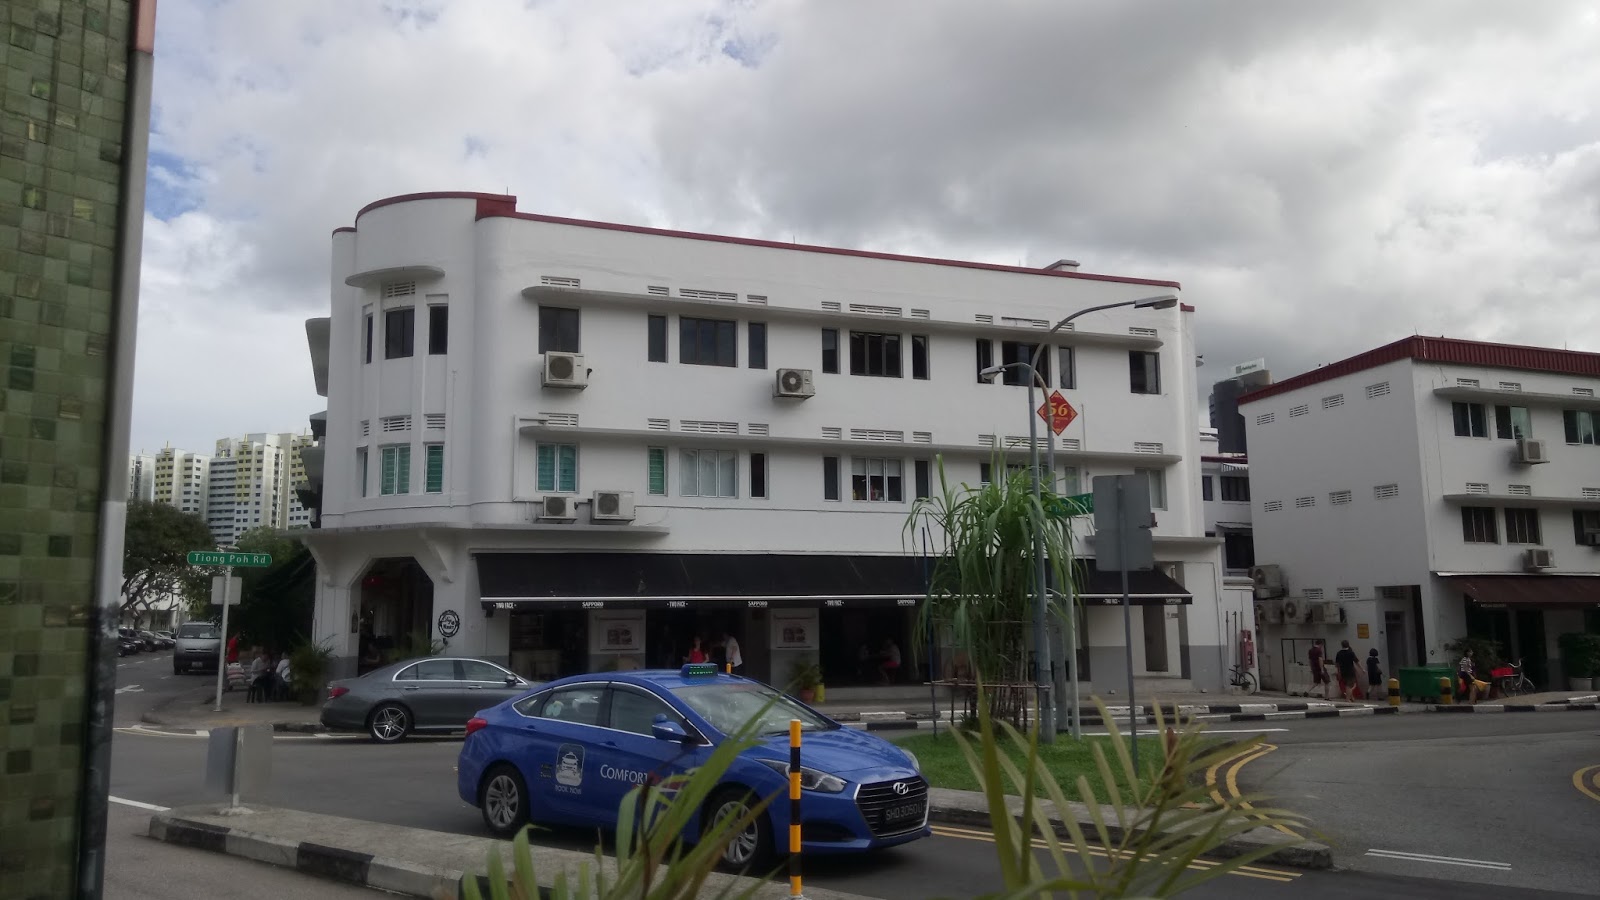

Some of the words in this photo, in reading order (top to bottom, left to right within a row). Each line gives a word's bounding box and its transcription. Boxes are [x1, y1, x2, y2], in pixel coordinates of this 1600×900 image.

[1047, 402, 1068, 417] 56
[194, 553, 225, 565] Tiong
[229, 554, 249, 563] Poh
[253, 555, 266, 564] Rd
